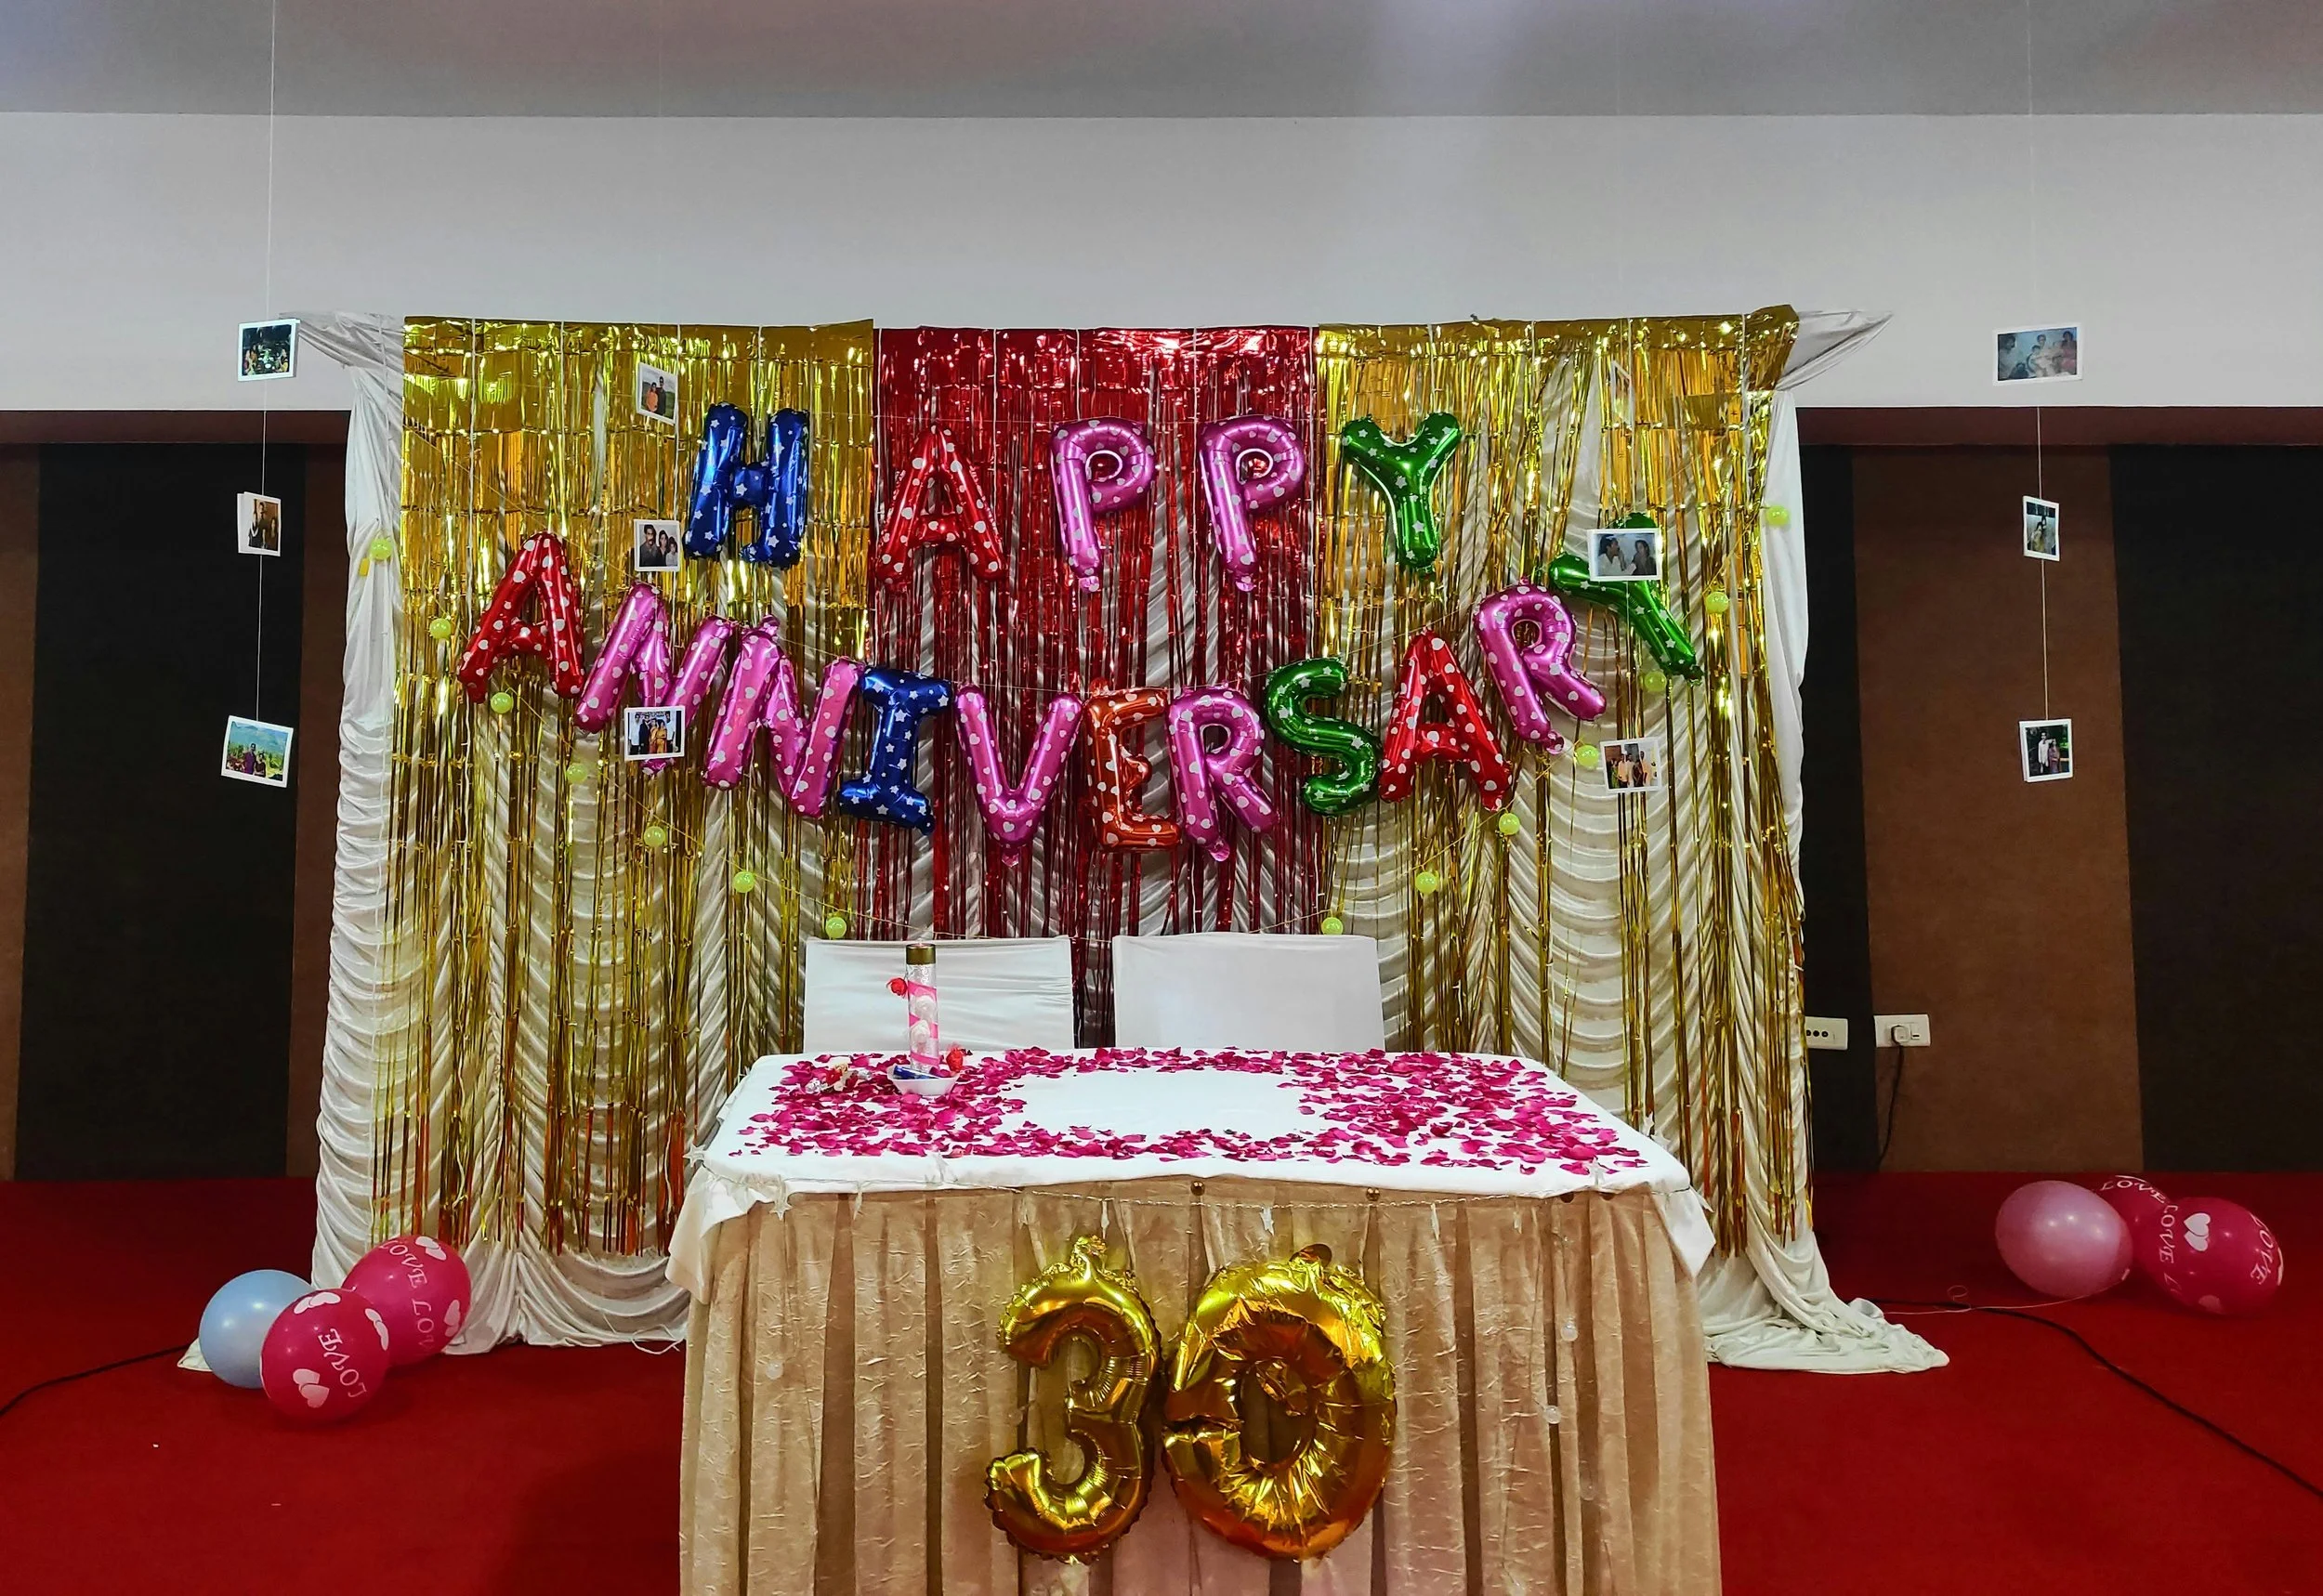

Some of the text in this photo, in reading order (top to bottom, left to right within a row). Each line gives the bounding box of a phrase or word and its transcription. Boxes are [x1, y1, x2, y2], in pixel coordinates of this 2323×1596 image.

[683, 401, 1462, 592] HAPPY
[457, 512, 1703, 867] ANNIVERSARY
[2100, 1180, 2166, 1204] LOVE
[378, 1239, 428, 1289] LOVE
[2159, 1204, 2179, 1264] LOVE
[2250, 1210, 2274, 1286] LOVE
[317, 1328, 367, 1398] LOVE
[984, 1236, 1398, 1565] 30
